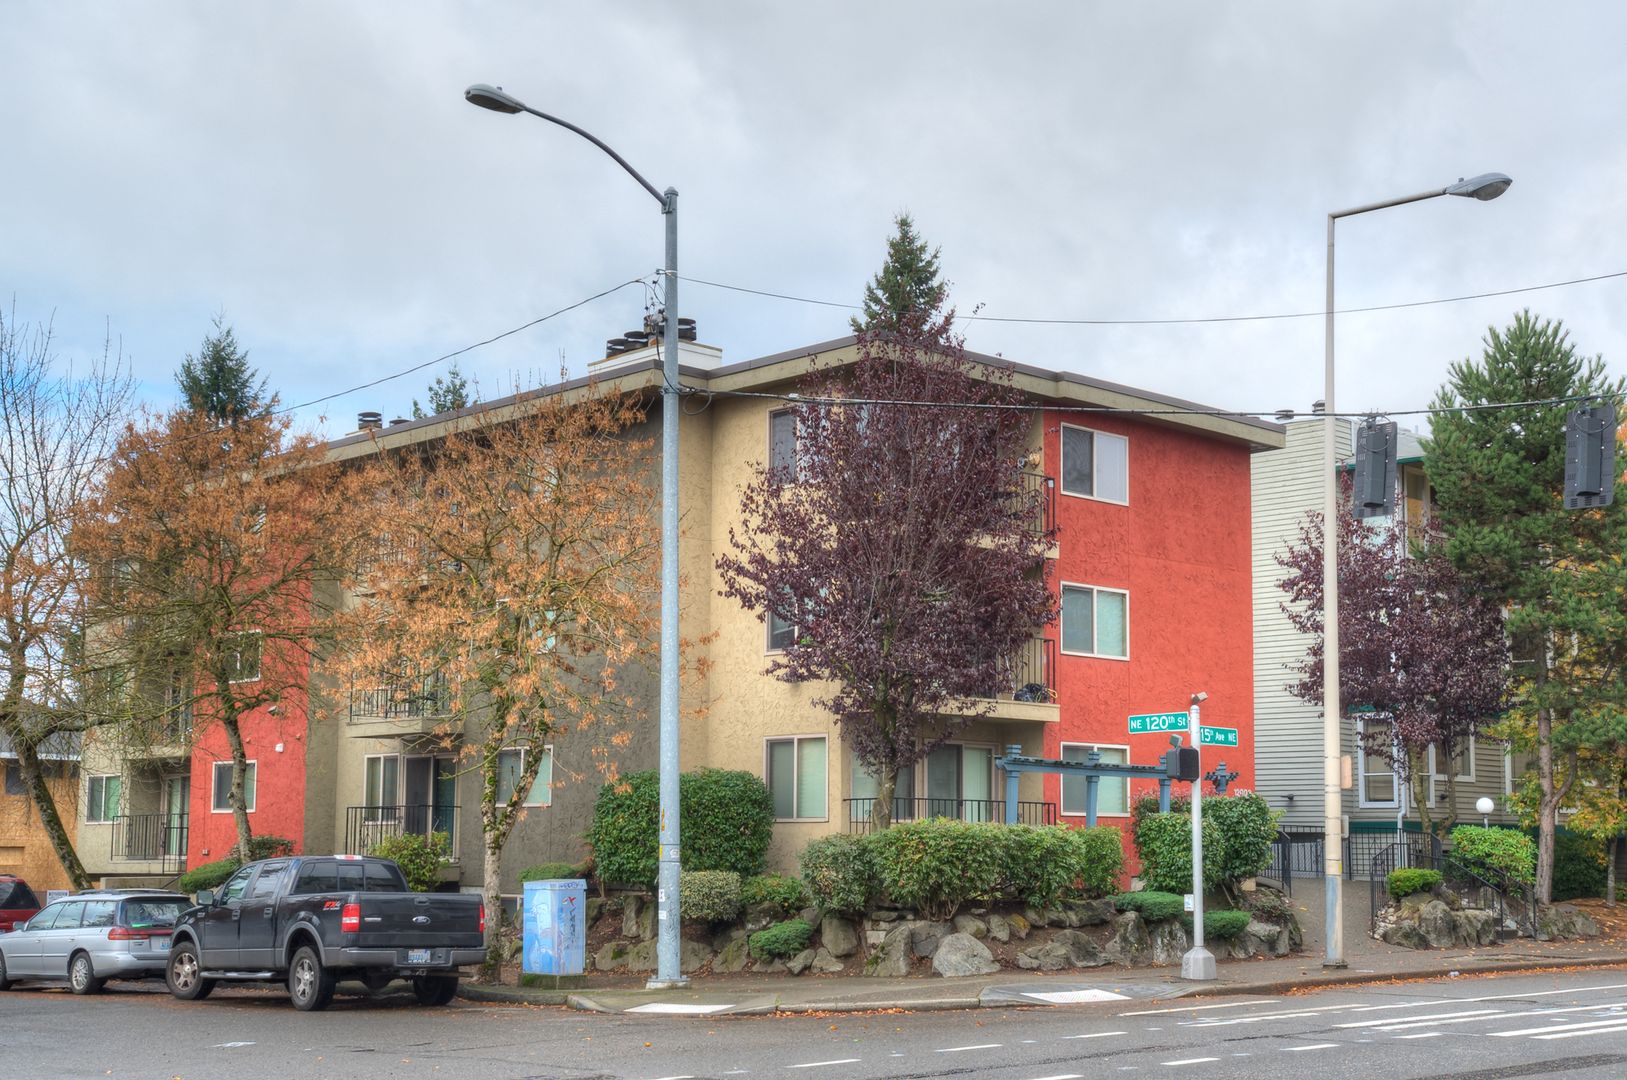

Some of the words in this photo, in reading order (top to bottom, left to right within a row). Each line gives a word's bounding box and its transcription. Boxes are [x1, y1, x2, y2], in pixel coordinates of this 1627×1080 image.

[1131, 720, 1142, 729] NE
[1146, 716, 1175, 730] 120th
[1178, 716, 1186, 726] St
[1201, 728, 1213, 742] 15th
[1215, 732, 1225, 741] Ave
[1228, 733, 1236, 742] NE
